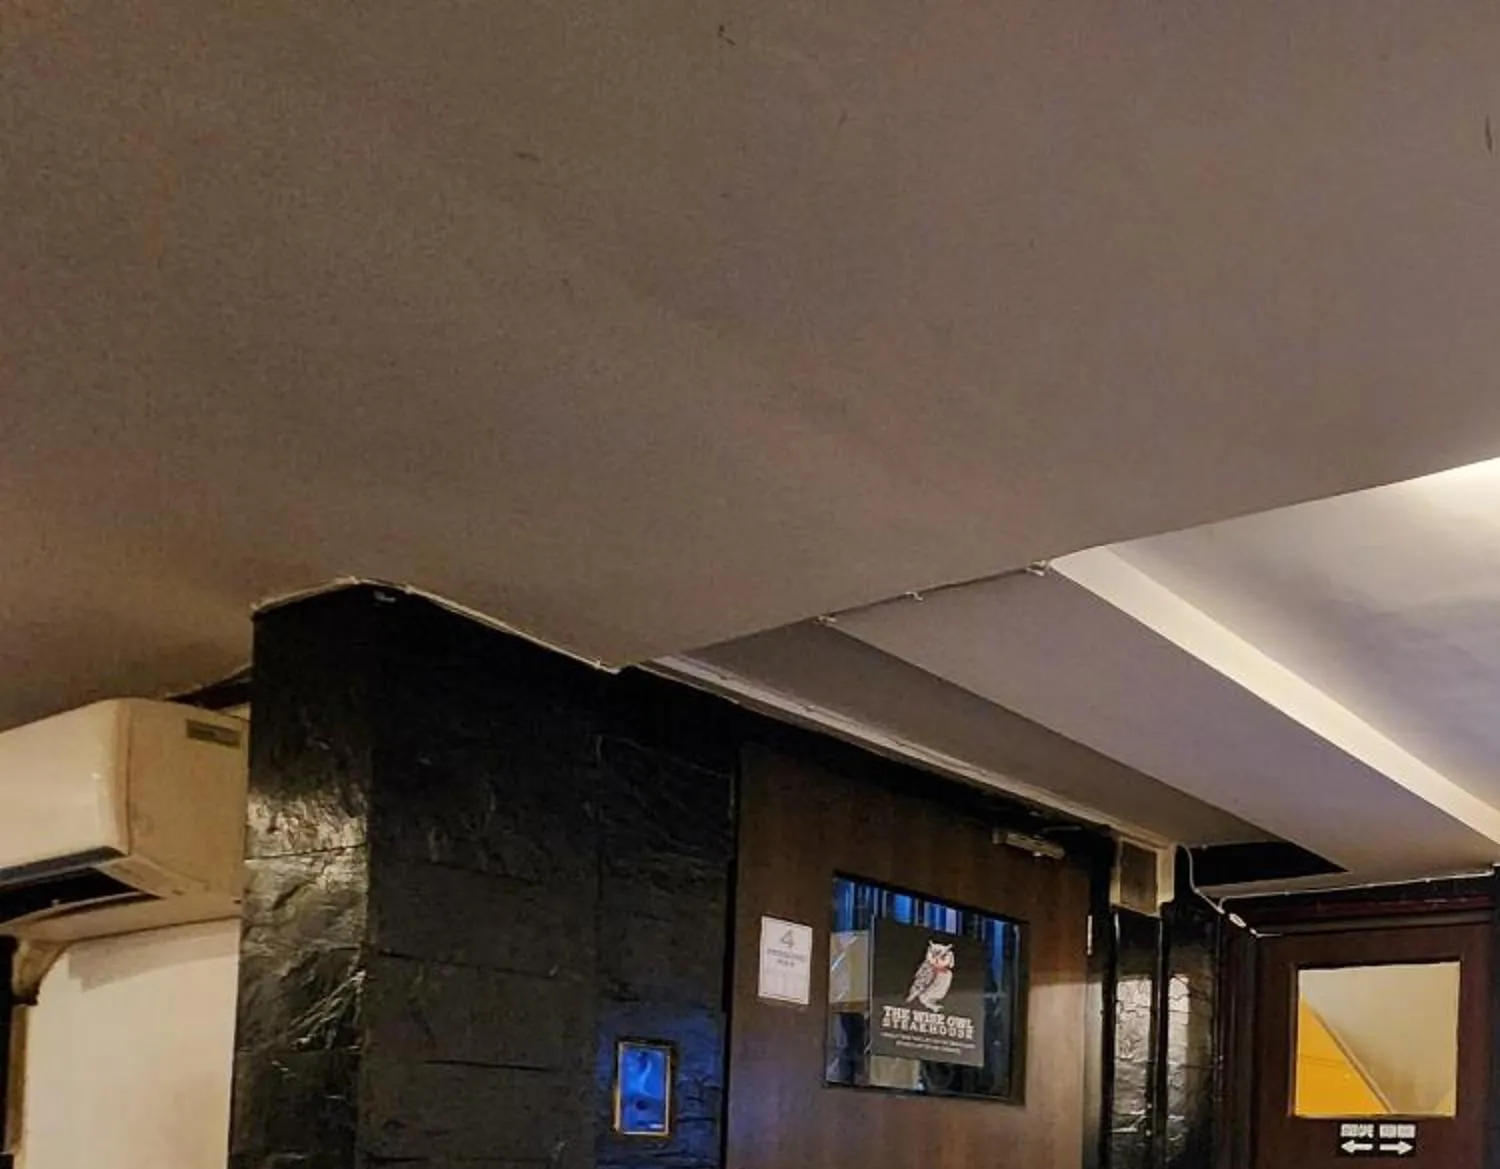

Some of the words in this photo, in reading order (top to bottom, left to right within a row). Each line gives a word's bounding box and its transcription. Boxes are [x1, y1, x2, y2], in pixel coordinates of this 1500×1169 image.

[881, 1017, 975, 1040] STEAKHOUSE
[883, 1005, 910, 1022] THE
[912, 1009, 946, 1025] WISE
[946, 1015, 973, 1030] OWL
